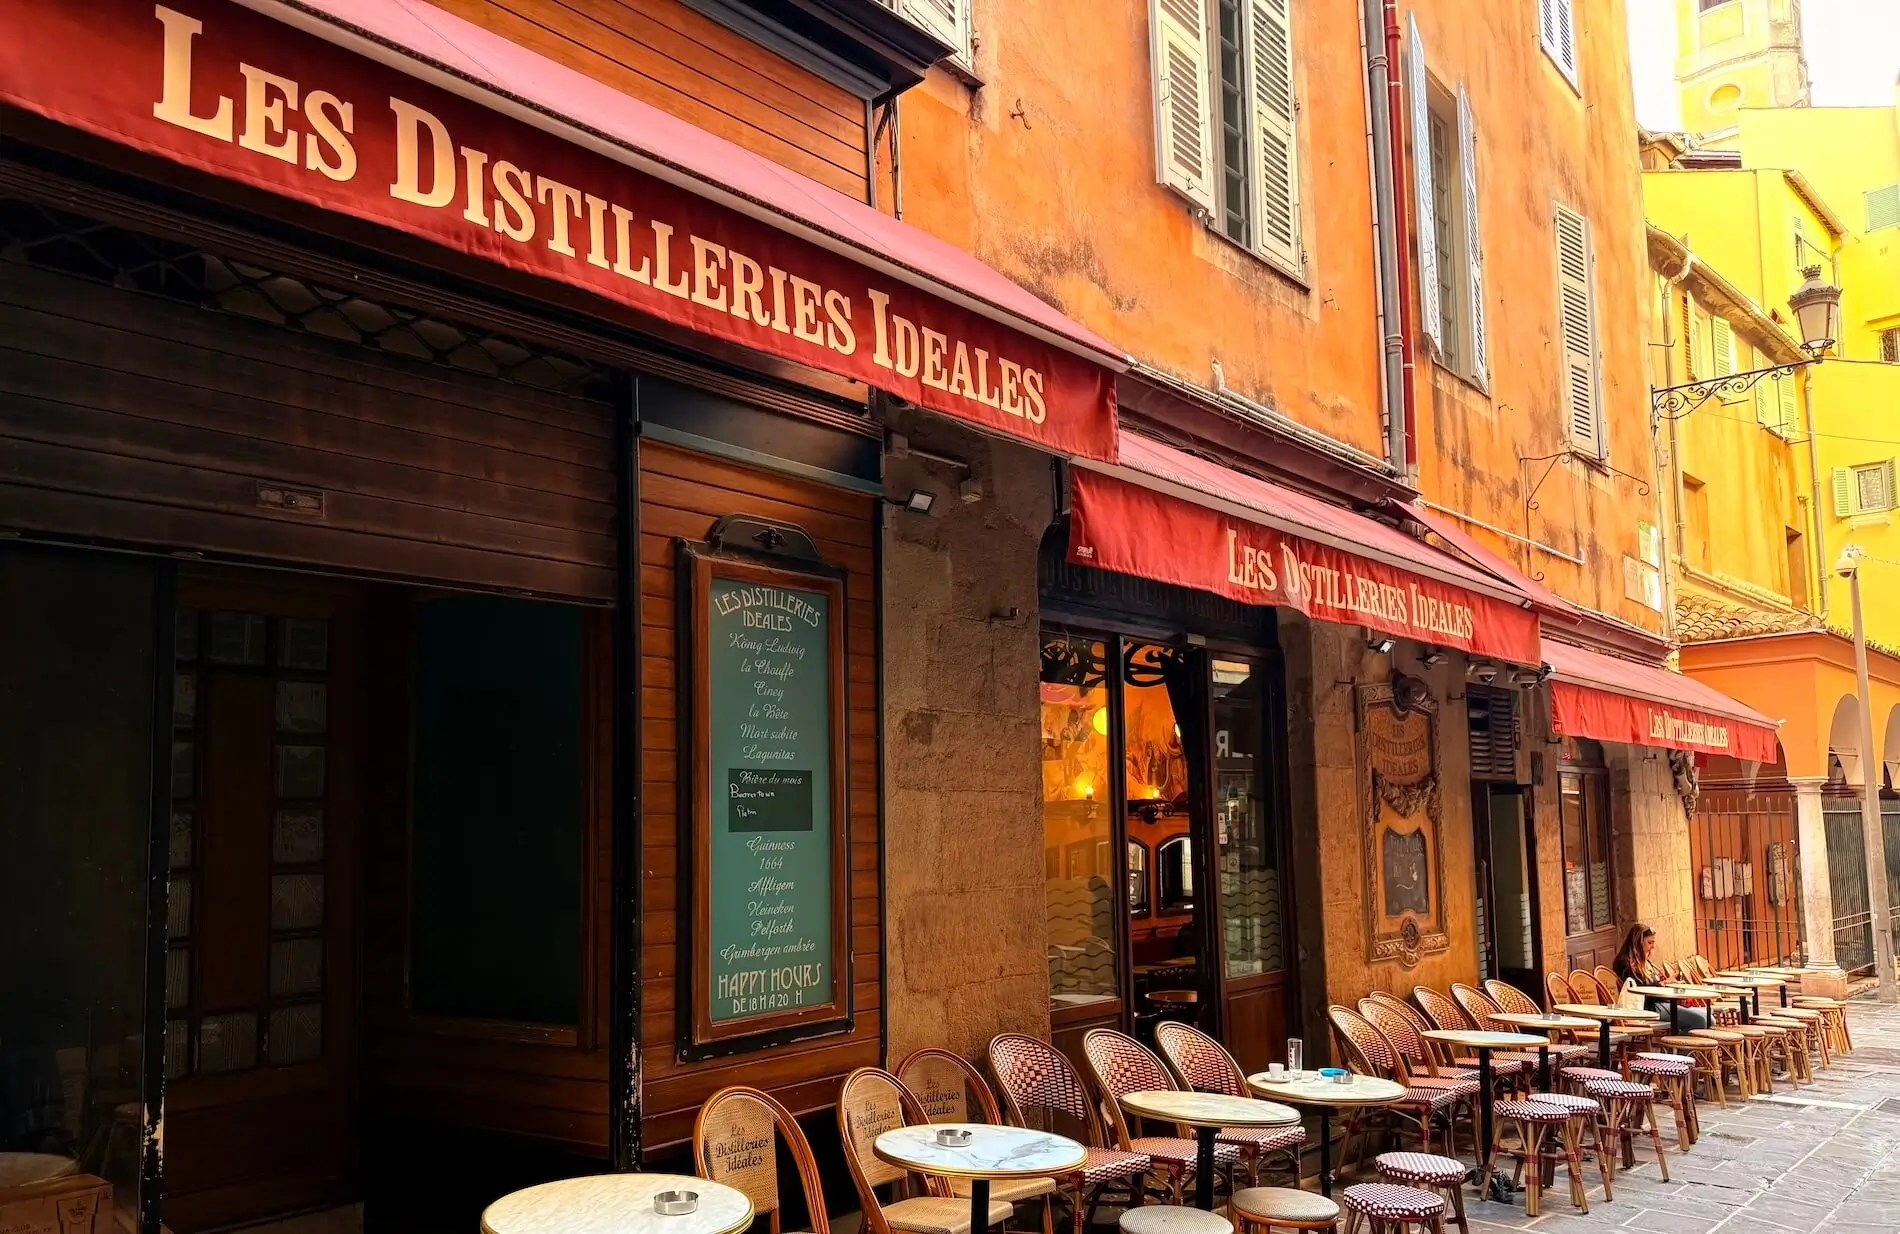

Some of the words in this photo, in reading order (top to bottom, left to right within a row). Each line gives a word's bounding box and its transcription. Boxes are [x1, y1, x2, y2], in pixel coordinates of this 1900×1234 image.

[152, 4, 359, 182] LES
[389, 96, 858, 356] DISTILLERIES
[868, 288, 1048, 425] IDEALES
[1227, 528, 1277, 591] LES
[1280, 542, 1408, 625] DSTILLERIES
[1409, 582, 1473, 640] IDEALES
[714, 590, 742, 616] LES
[741, 587, 821, 628] DISTILLERIES
[742, 610, 793, 632] IDEALES
[729, 632, 763, 655] König
[765, 637, 807, 660] Ludwig
[754, 659, 794, 682] Chouffe
[753, 681, 784, 702] Ciney
[740, 723, 769, 739] Mort
[770, 726, 798, 741] subite
[742, 744, 796, 765] Lagunitas
[1382, 758, 1419, 776] IDEALES
[740, 771, 768, 785] Bière
[768, 773, 779, 785] du
[780, 776, 802, 785] mois
[746, 836, 796, 857] Guinness
[759, 856, 783, 870] 1664
[747, 877, 795, 897] Affligem
[747, 900, 795, 917] Heineken
[750, 919, 793, 940] Pelforth
[720, 942, 781, 965] Grimbergen
[783, 937, 816, 954] ambrée
[718, 969, 767, 999] HAPPY
[770, 962, 821, 992] HOURS
[733, 998, 747, 1014] DE
[777, 993, 789, 1007] 20
[926, 1079, 940, 1089] Les
[865, 1101, 877, 1111] Les
[730, 1123, 746, 1137] Les
[856, 1110, 895, 1129] Distilleries
[715, 1137, 769, 1158] Distilleries
[726, 1152, 763, 1173] Idéales
